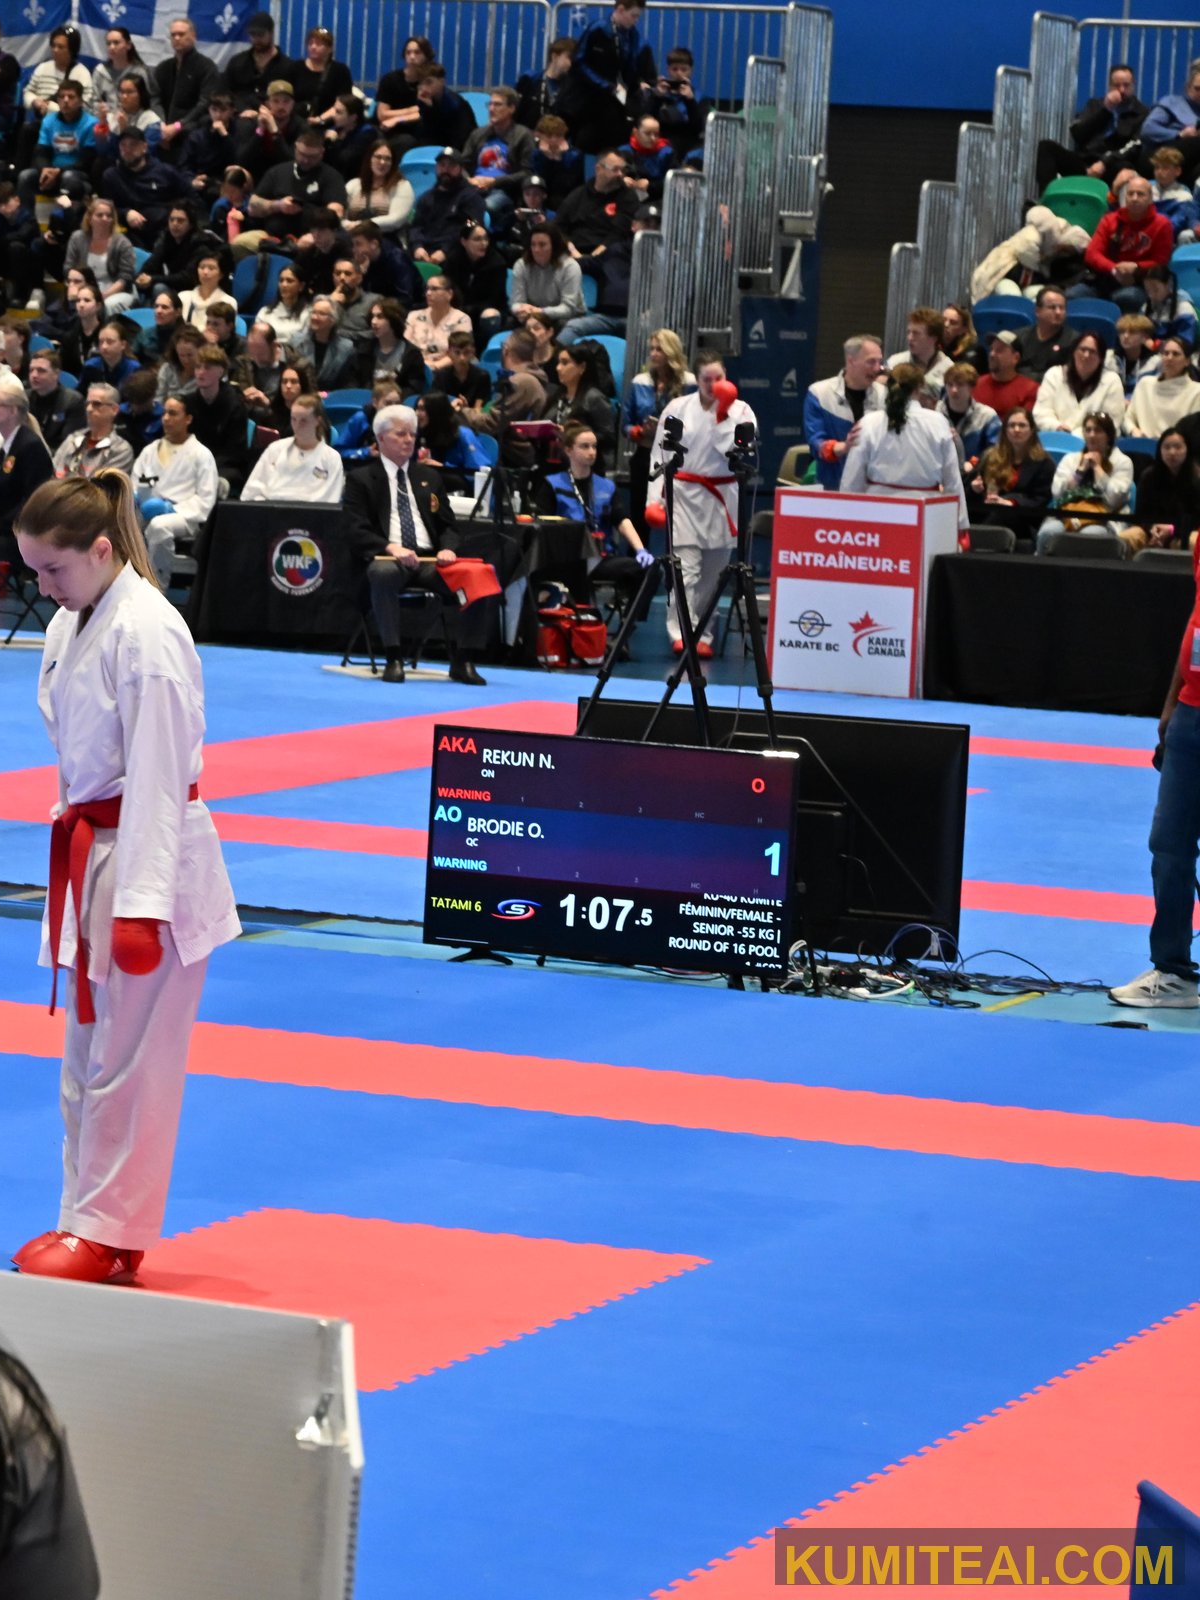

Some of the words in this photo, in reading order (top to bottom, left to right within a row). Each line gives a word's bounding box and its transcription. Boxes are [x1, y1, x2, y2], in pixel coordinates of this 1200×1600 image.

[815, 529, 880, 547] COACH
[282, 555, 312, 569] WKF
[779, 639, 822, 651] KARATE
[825, 642, 840, 652] BC
[867, 636, 906, 648] KARATE
[867, 647, 906, 658] CANADA
[438, 735, 477, 754] AKA
[482, 748, 534, 768] REKUN
[538, 753, 555, 769] N.
[481, 768, 495, 778] ON
[751, 777, 766, 794] 0
[437, 787, 492, 802] WARNING
[433, 804, 462, 823] AO
[467, 817, 524, 837] BRODIE
[527, 822, 545, 839] O.
[465, 837, 479, 847] QC
[433, 856, 488, 871] WARNING
[764, 842, 781, 876] 1
[431, 896, 472, 911] TATAMI
[474, 901, 482, 912] 6
[679, 901, 774, 924] FÉMININ/FEMALE
[692, 921, 735, 937] SENIOR
[737, 928, 756, 939] -55
[758, 930, 775, 941] KG
[668, 936, 711, 952] ROUND
[713, 940, 730, 954] OF
[732, 943, 747, 955] 16
[749, 946, 780, 958] POOL
